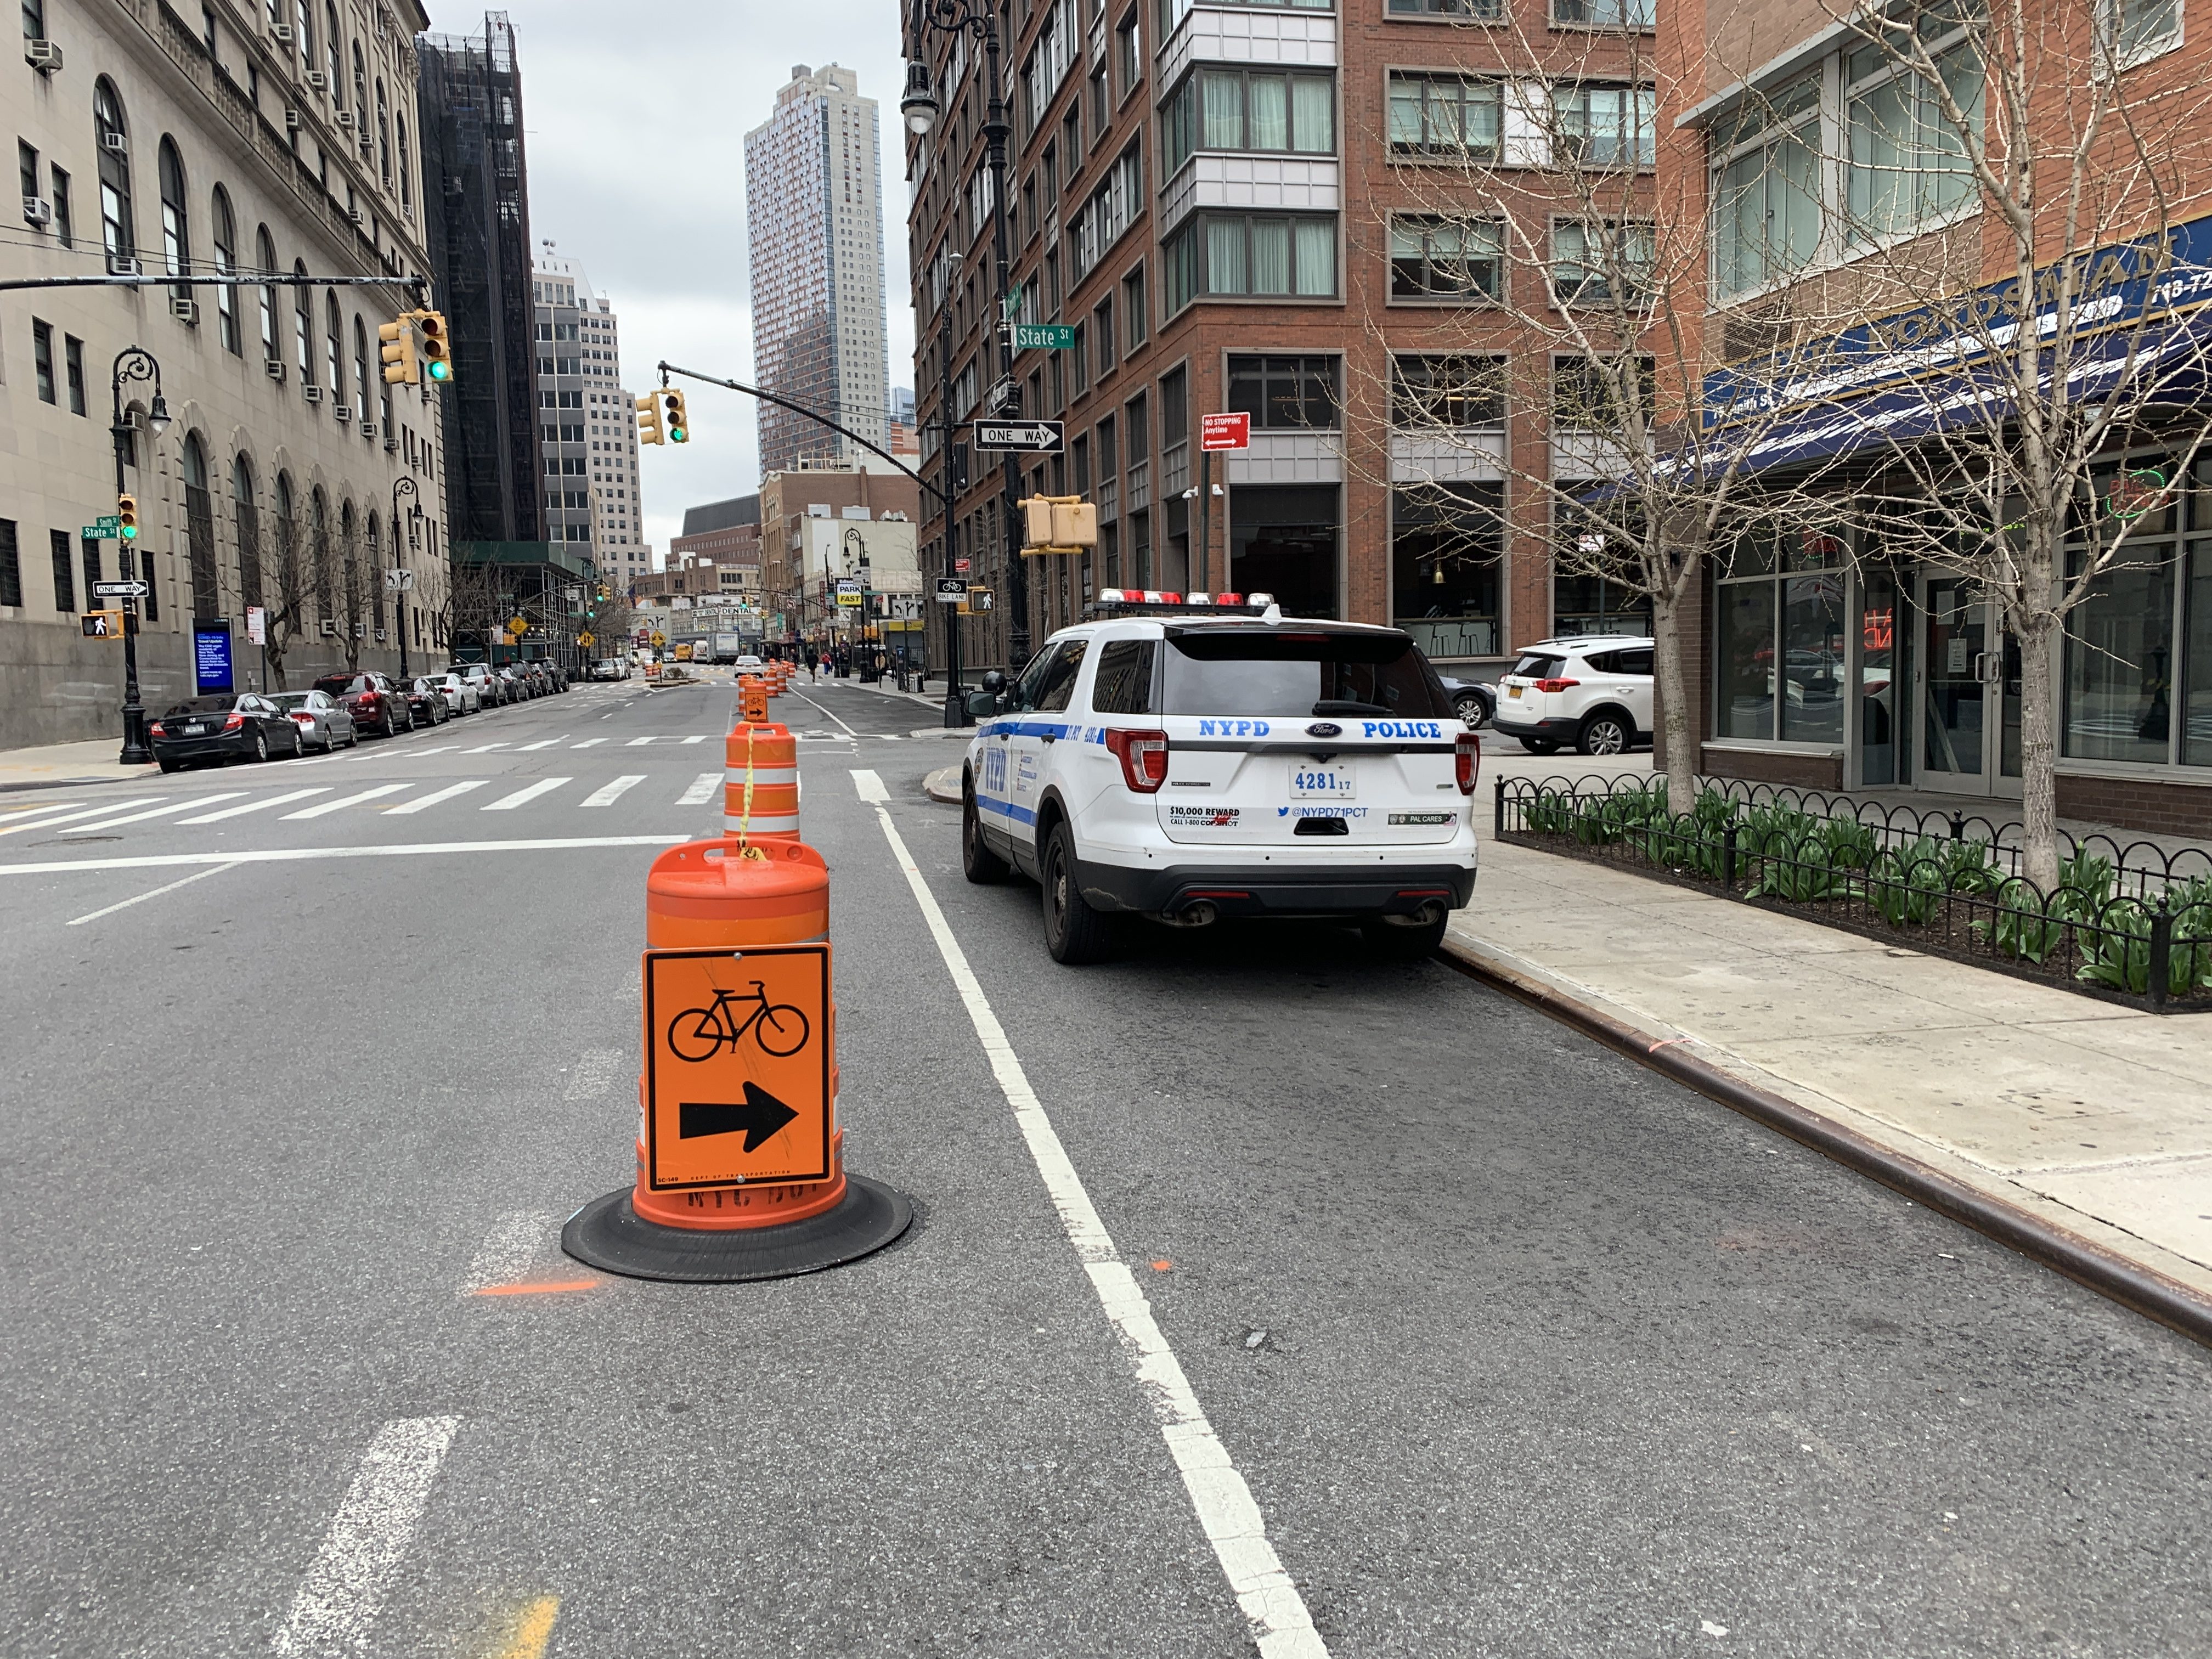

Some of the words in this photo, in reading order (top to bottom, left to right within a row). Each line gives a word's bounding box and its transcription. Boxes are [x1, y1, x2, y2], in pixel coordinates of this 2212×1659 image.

[1019, 328, 1054, 346] State
[1060, 329, 1069, 340] St
[1214, 417, 1241, 426] STOPPING
[989, 430, 1013, 441] ONE
[1025, 431, 1050, 442] WAY
[1205, 426, 1228, 435] Anytime
[100, 518, 112, 527] Smith
[85, 526, 107, 537] State
[1199, 720, 1270, 736] NYPD
[1314, 724, 1335, 734] Ford
[1362, 722, 1441, 738] POLICE
[986, 747, 1006, 792] NYPD
[1295, 772, 1335, 789] 4281
[1339, 781, 1351, 789] 17
[1170, 806, 1203, 816] $10,000
[1205, 808, 1240, 816] REWARD
[1292, 806, 1368, 818] @NYPD71PCT
[726, 1170, 791, 1178] TRANSPORTATION
